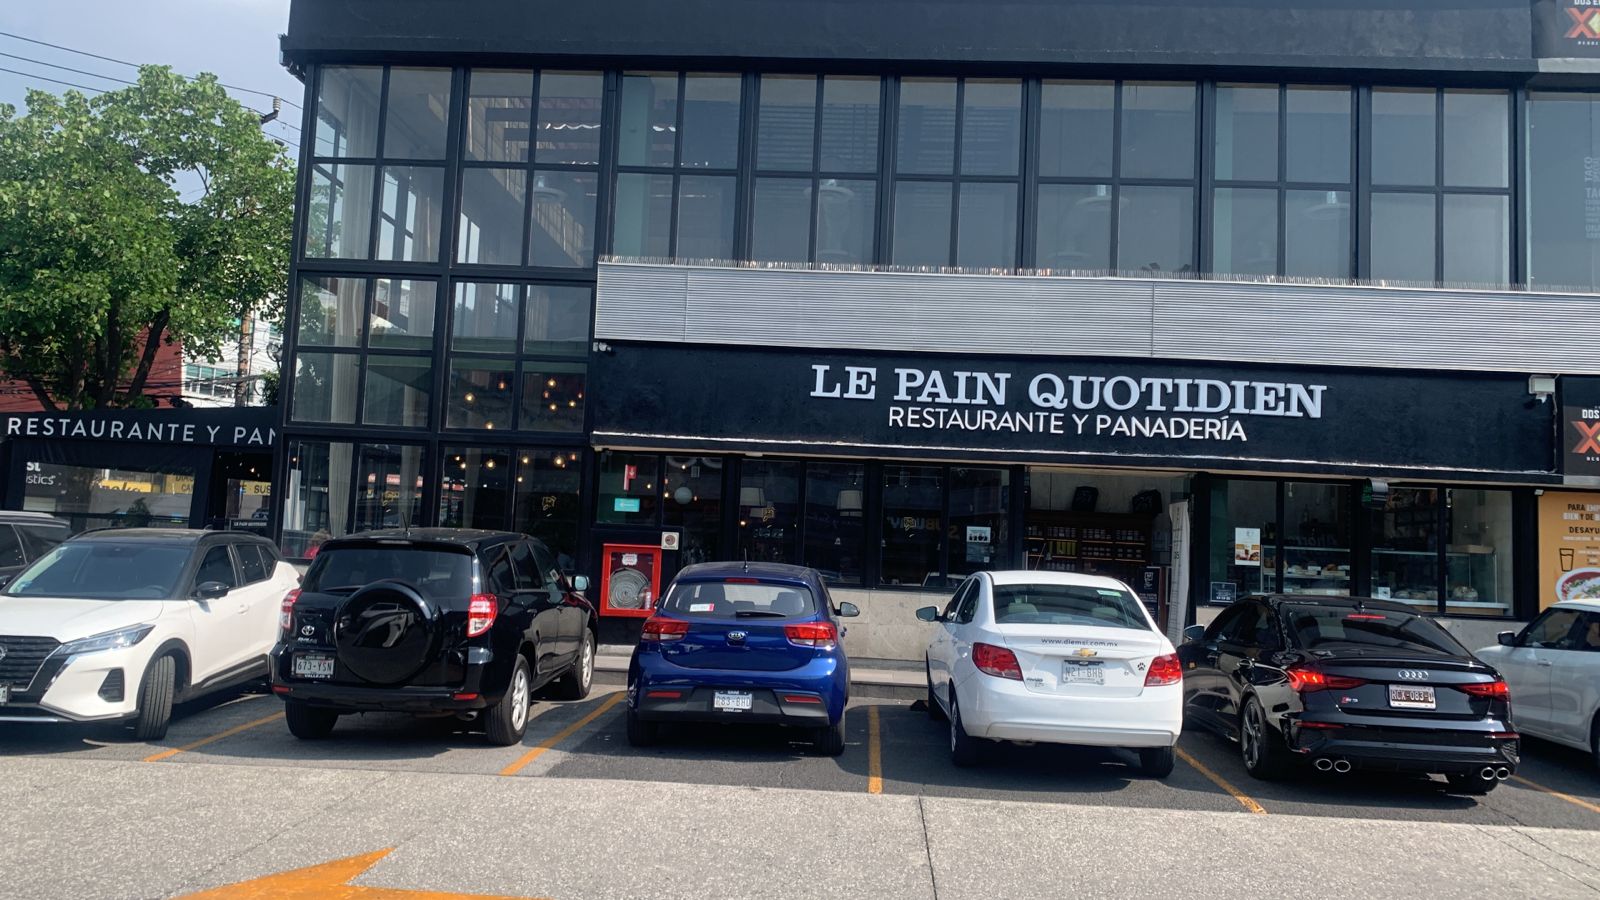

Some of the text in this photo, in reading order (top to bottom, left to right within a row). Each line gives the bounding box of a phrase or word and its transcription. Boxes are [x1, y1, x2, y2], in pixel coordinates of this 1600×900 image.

[1586, 188, 1600, 198] TA
[810, 364, 1327, 418] LE PAIN QUOTIDIEN
[7, 417, 196, 442] RESTAURANTE
[206, 425, 221, 443] Y
[888, 407, 1247, 441] RESTAURANTE Y PANADERÍA
